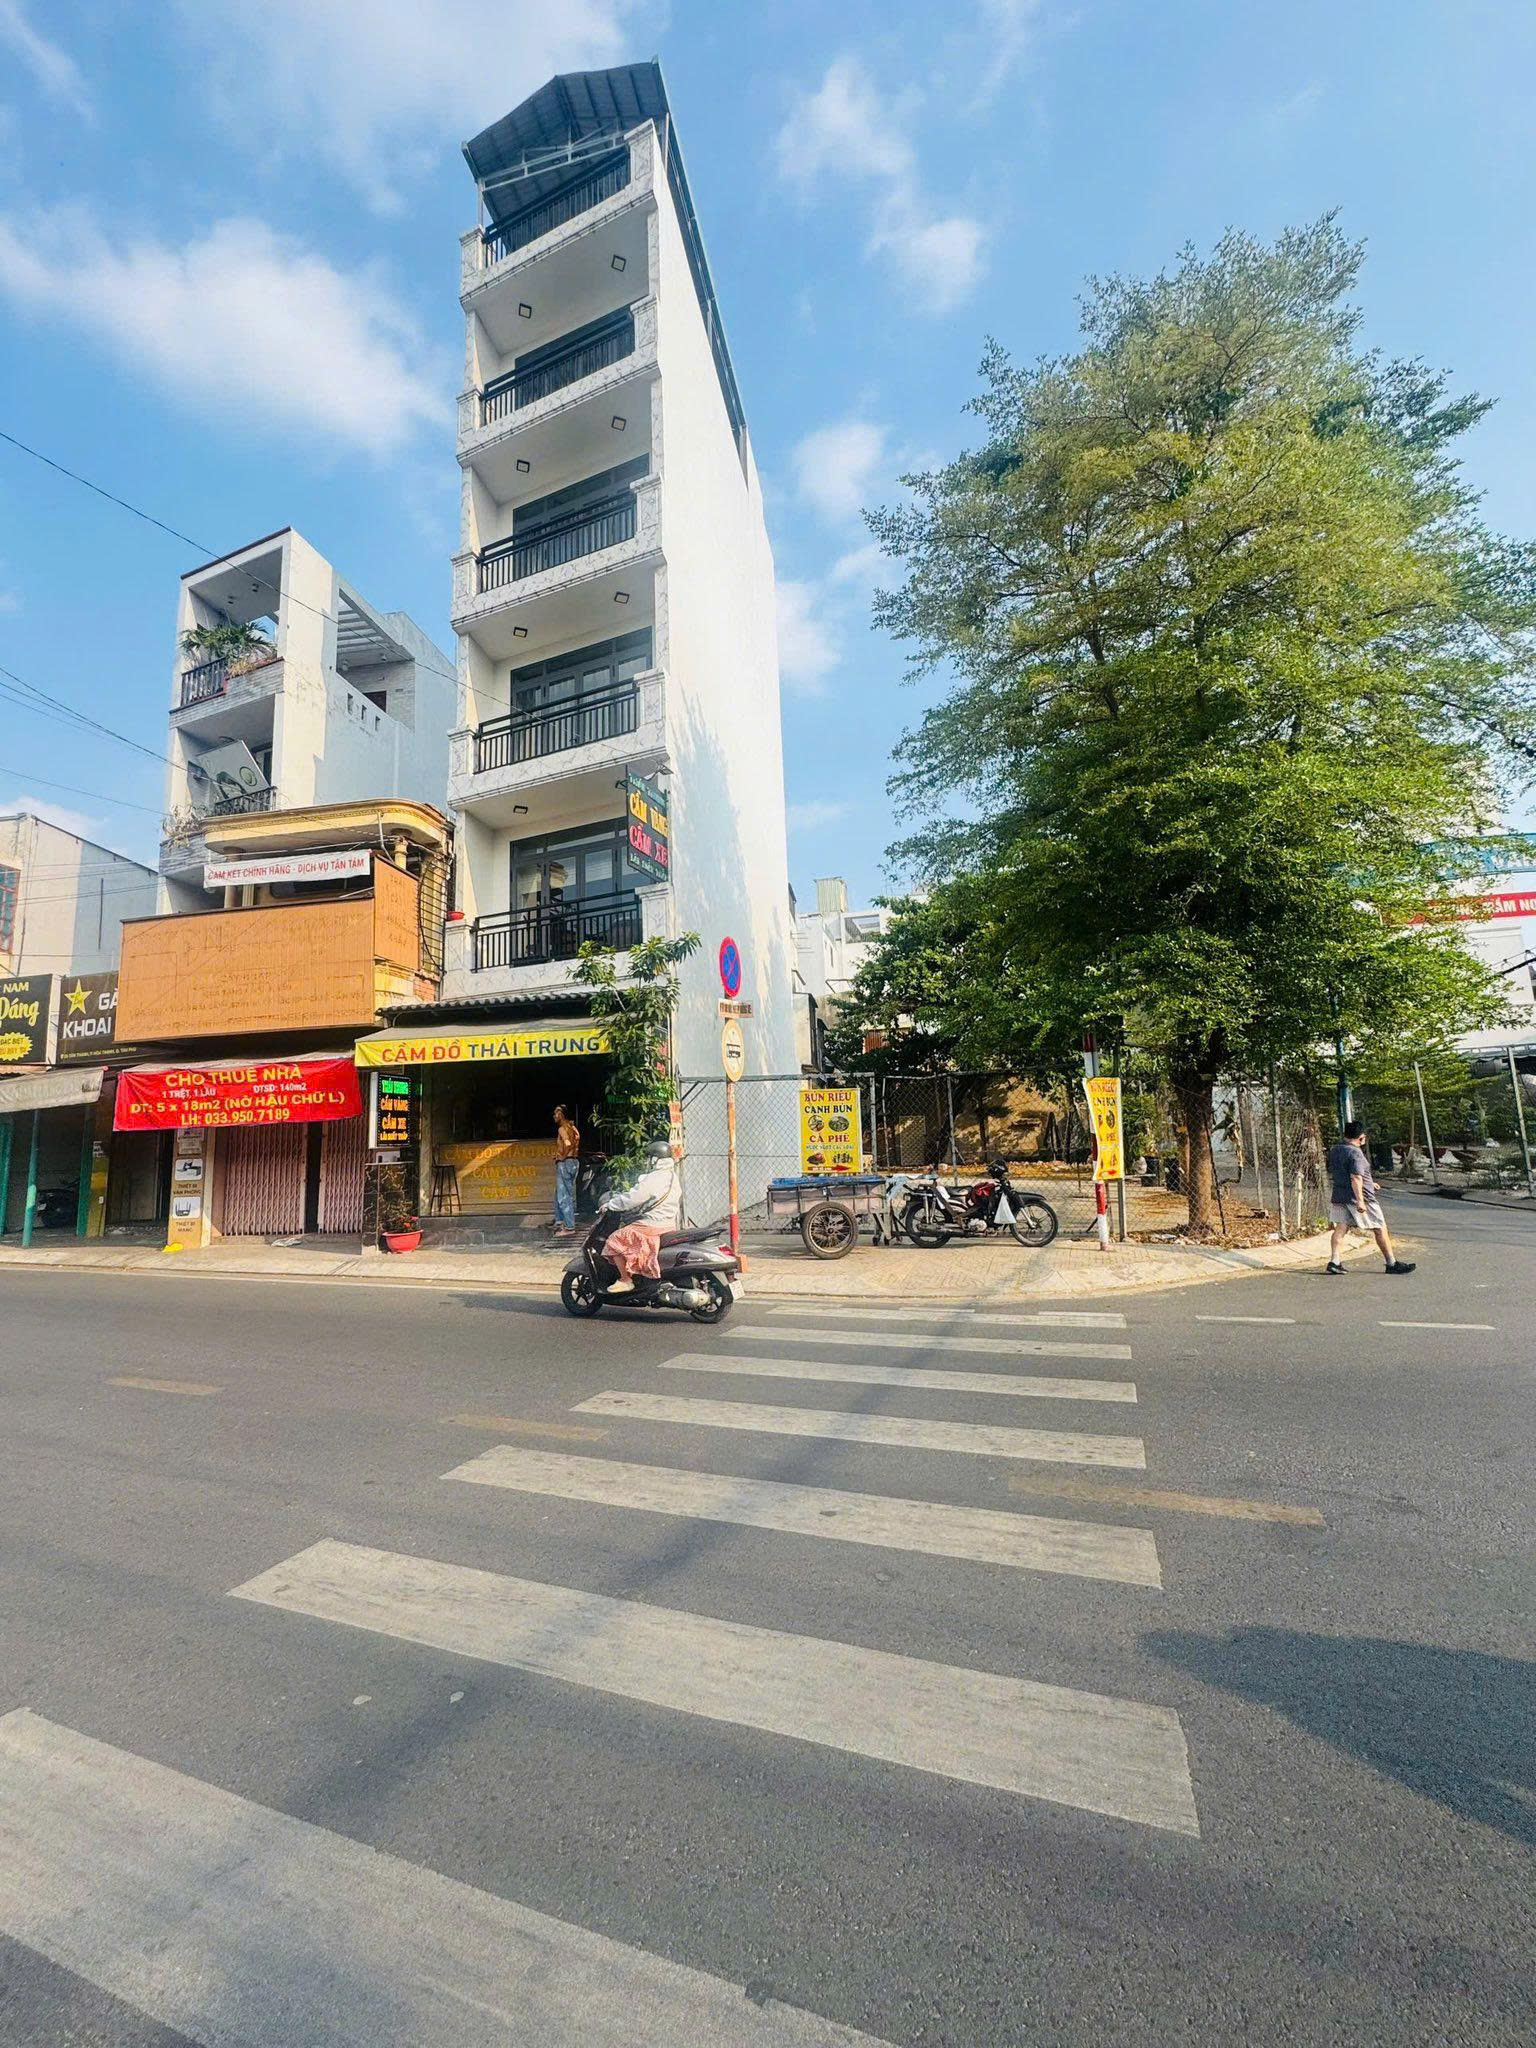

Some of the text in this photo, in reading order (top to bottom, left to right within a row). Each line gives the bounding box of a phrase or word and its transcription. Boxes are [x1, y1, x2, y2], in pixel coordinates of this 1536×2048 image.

[3, 981, 30, 993] NAM
[62, 1017, 112, 1039] KHOAI
[381, 1036, 600, 1063] CẦM ĐỒ THÁI TRUNG
[165, 1064, 302, 1087] CHO THUÊ NHÀ
[162, 1090, 166, 1098] 1
[194, 1088, 198, 1096] 1
[804, 1091, 825, 1102] BÚN
[157, 1102, 166, 1113] 5
[169, 1103, 178, 1112] x
[183, 1100, 221, 1111] 18m2
[255, 1093, 287, 1107] HẬU
[292, 1091, 326, 1104] CHỮ
[329, 1091, 345, 1104] L)
[804, 1103, 852, 1113] CANH BÚN
[181, 1108, 290, 1125] LH: 033.950.7189
[828, 1133, 850, 1142] PHÊ
